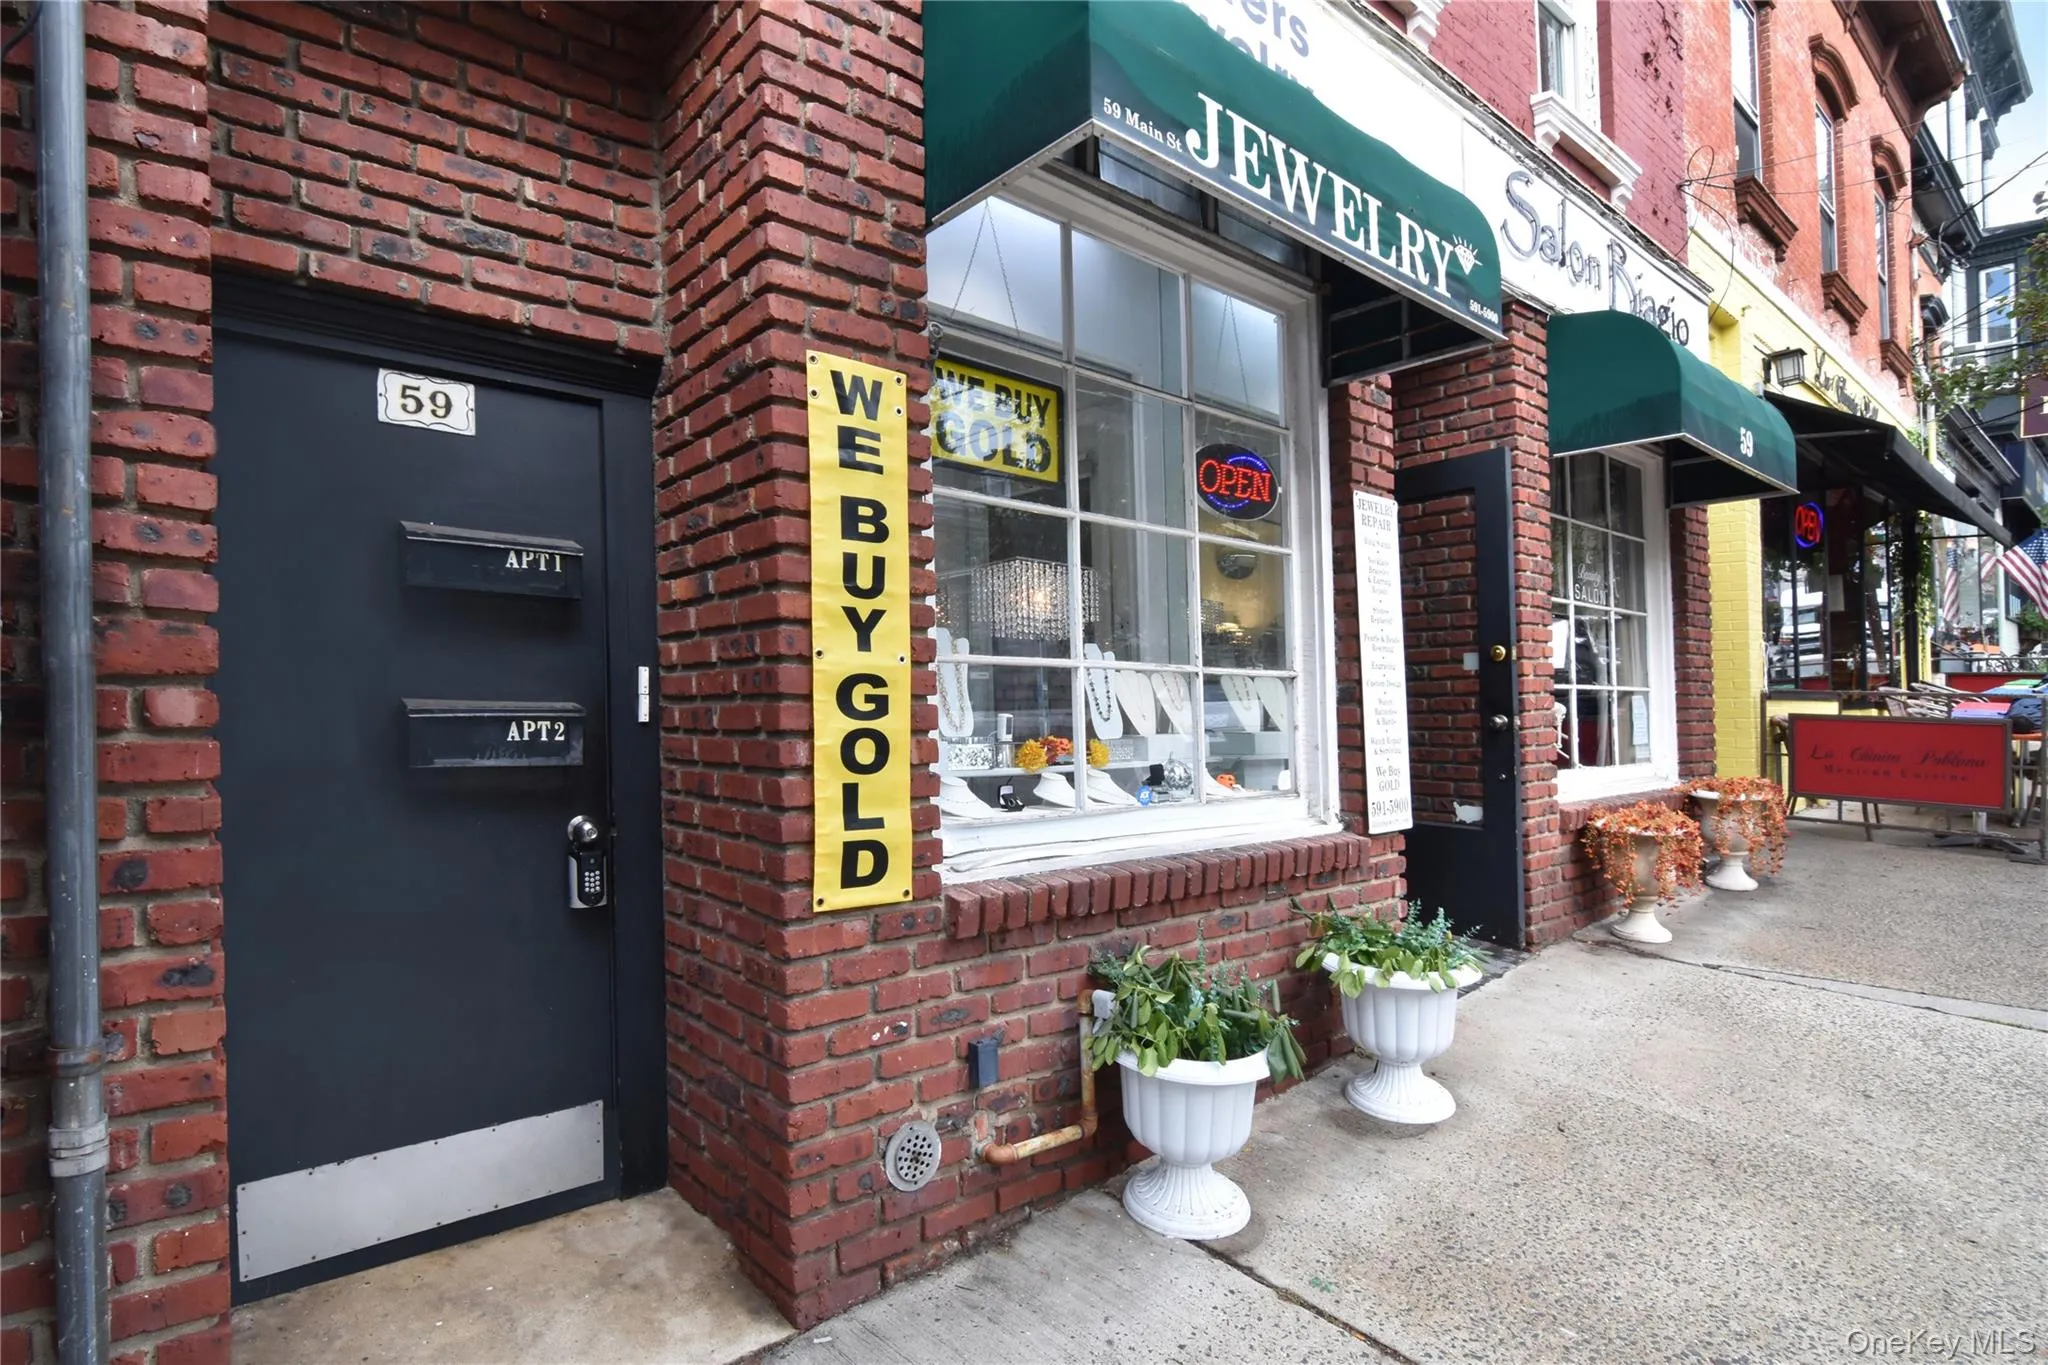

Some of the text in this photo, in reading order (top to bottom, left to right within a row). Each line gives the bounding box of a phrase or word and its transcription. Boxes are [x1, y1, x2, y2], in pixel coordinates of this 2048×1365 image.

[1103, 97, 1183, 152] 59 Main St
[1185, 92, 1454, 299] JEWELRY
[1501, 170, 1602, 291] Salon
[400, 384, 453, 419] 59
[935, 366, 1051, 428] WE BUY
[936, 411, 1052, 473] GOLD
[1740, 426, 1754, 458] 59
[1198, 458, 1273, 502] OPEN
[1356, 498, 1393, 517] JEWELRY
[1361, 514, 1391, 532] REPAIR
[505, 550, 550, 571] APT
[1574, 583, 1608, 606] SALON
[829, 369, 891, 890] WE BUY GOLD
[507, 720, 551, 741] APT
[1378, 778, 1400, 792] GOLD
[1371, 798, 1409, 818] 591-5900
